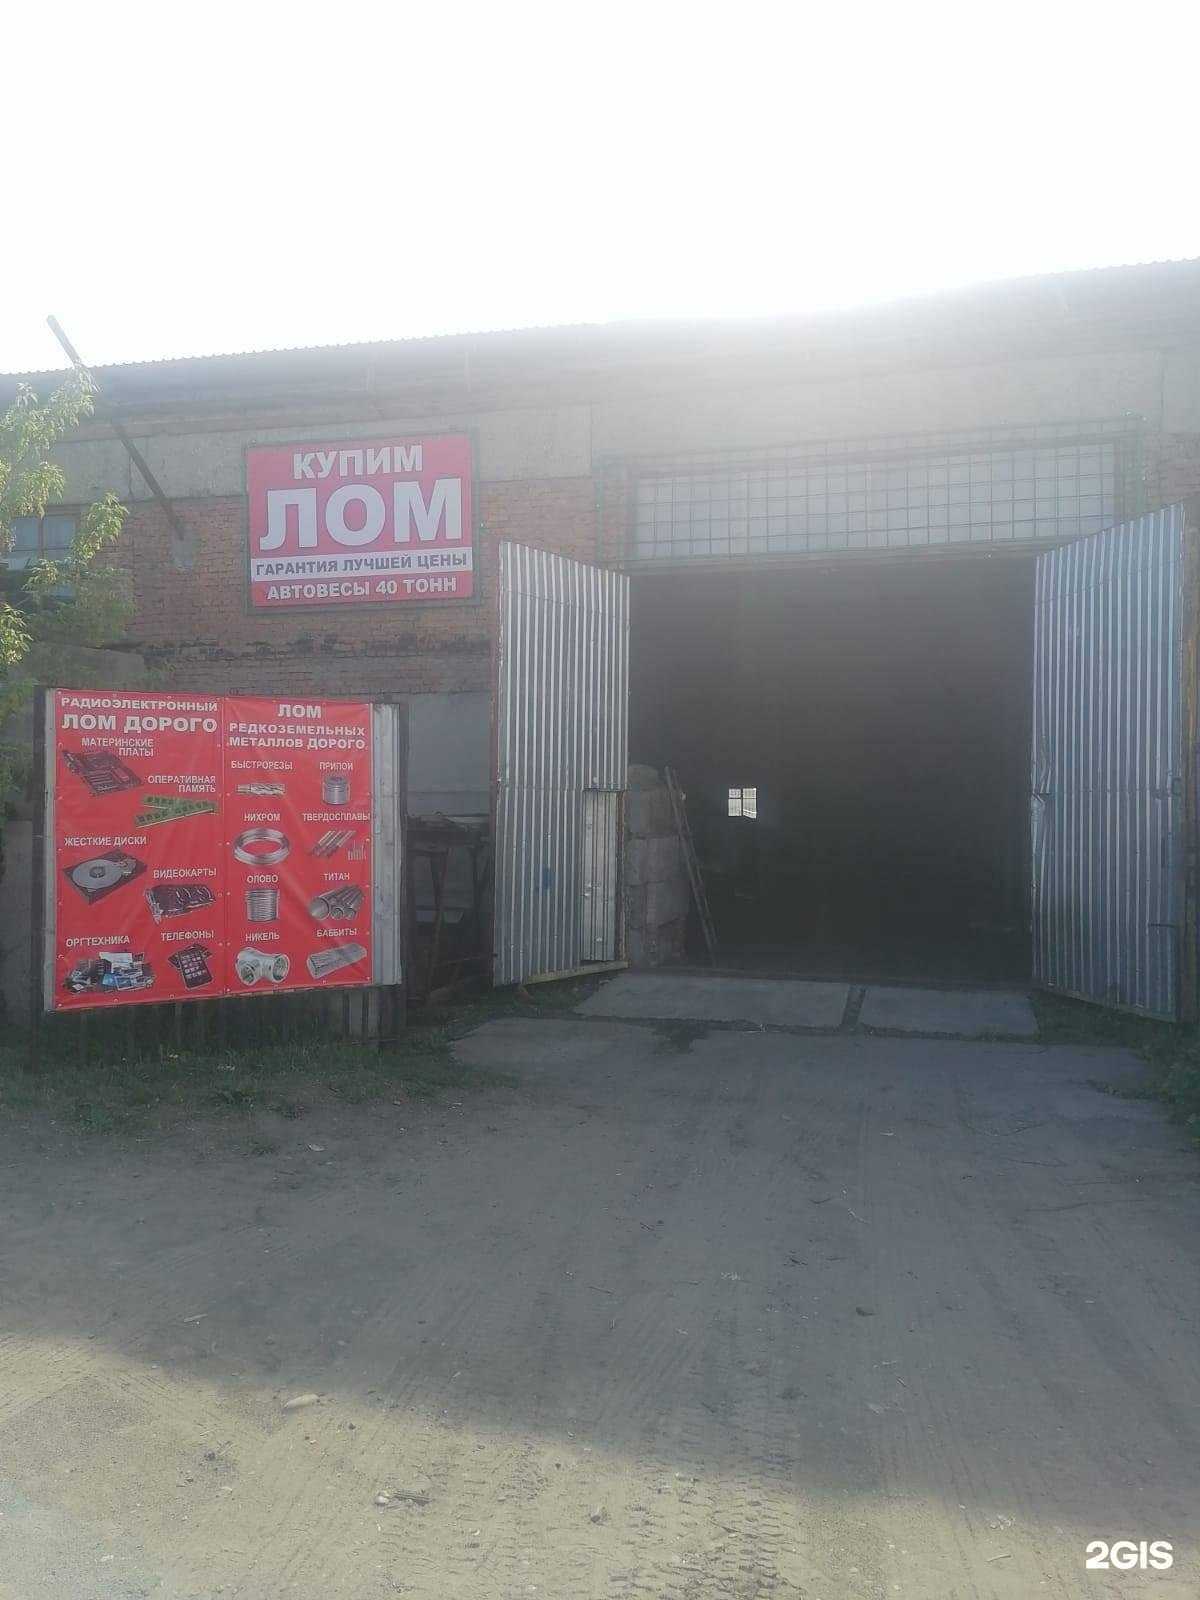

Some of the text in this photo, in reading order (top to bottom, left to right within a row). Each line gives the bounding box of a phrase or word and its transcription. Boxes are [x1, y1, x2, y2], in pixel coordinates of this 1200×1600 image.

[293, 444, 423, 480] КУПИМ
[259, 477, 462, 550] ЛОМ
[256, 552, 467, 576] ГАРАНТИЯ ЛУЧШЕЙ ЦЕНЫ
[267, 577, 457, 600] АВТОВЕСЫ 40 ТОНН
[61, 697, 218, 712] РАДИОЭЛЕКТРОННЫЙ
[277, 703, 322, 719] ЛОМ
[62, 714, 218, 733] ЛОМ ДОРОГО
[229, 722, 365, 736] РЕДКОЗЕМЕЛЬНЫХ
[81, 738, 154, 747] МАТЕРИНСКИЕ
[229, 736, 366, 750] МЕТАЛЛОВ ДОРОГО
[118, 747, 154, 757] ПЛАТЫ
[231, 760, 293, 770] БЫСТРОРЕЗЫ
[147, 775, 216, 784] ОПЕРАТИВНАЯ
[178, 784, 216, 793] ПАМЯТЬ
[243, 812, 281, 822] НИХРОМ
[303, 812, 370, 822] ТВЕРДОСПЛАВЫ
[64, 836, 147, 847] ЖЕСТКИЕ ДИСКИ
[153, 867, 217, 879] ВИДЕОКАРТЫ
[323, 872, 351, 881] ТИТАН
[246, 874, 279, 884] ОЛОВО
[160, 931, 214, 942] ТЕЛЕФОНЫ
[245, 931, 280, 942] НИКЕЛЬ
[316, 928, 358, 938] БАББИТЫ
[65, 935, 131, 947] ОРГТЕХНИКА
